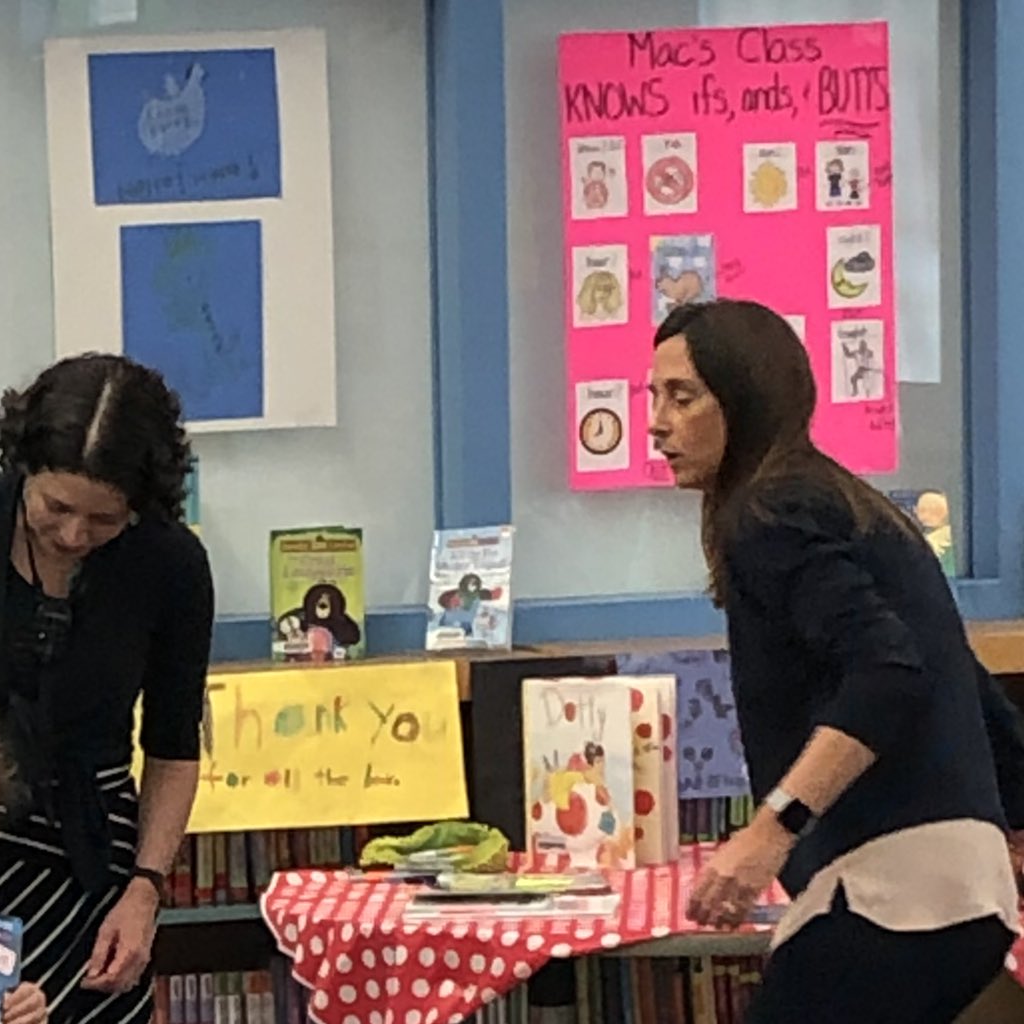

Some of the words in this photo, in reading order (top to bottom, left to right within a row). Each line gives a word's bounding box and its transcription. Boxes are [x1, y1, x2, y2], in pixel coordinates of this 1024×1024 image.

[627, 31, 716, 70] Mac's
[737, 28, 822, 63] Class
[565, 74, 670, 122] KNOWS
[817, 65, 889, 116] BUTTS
